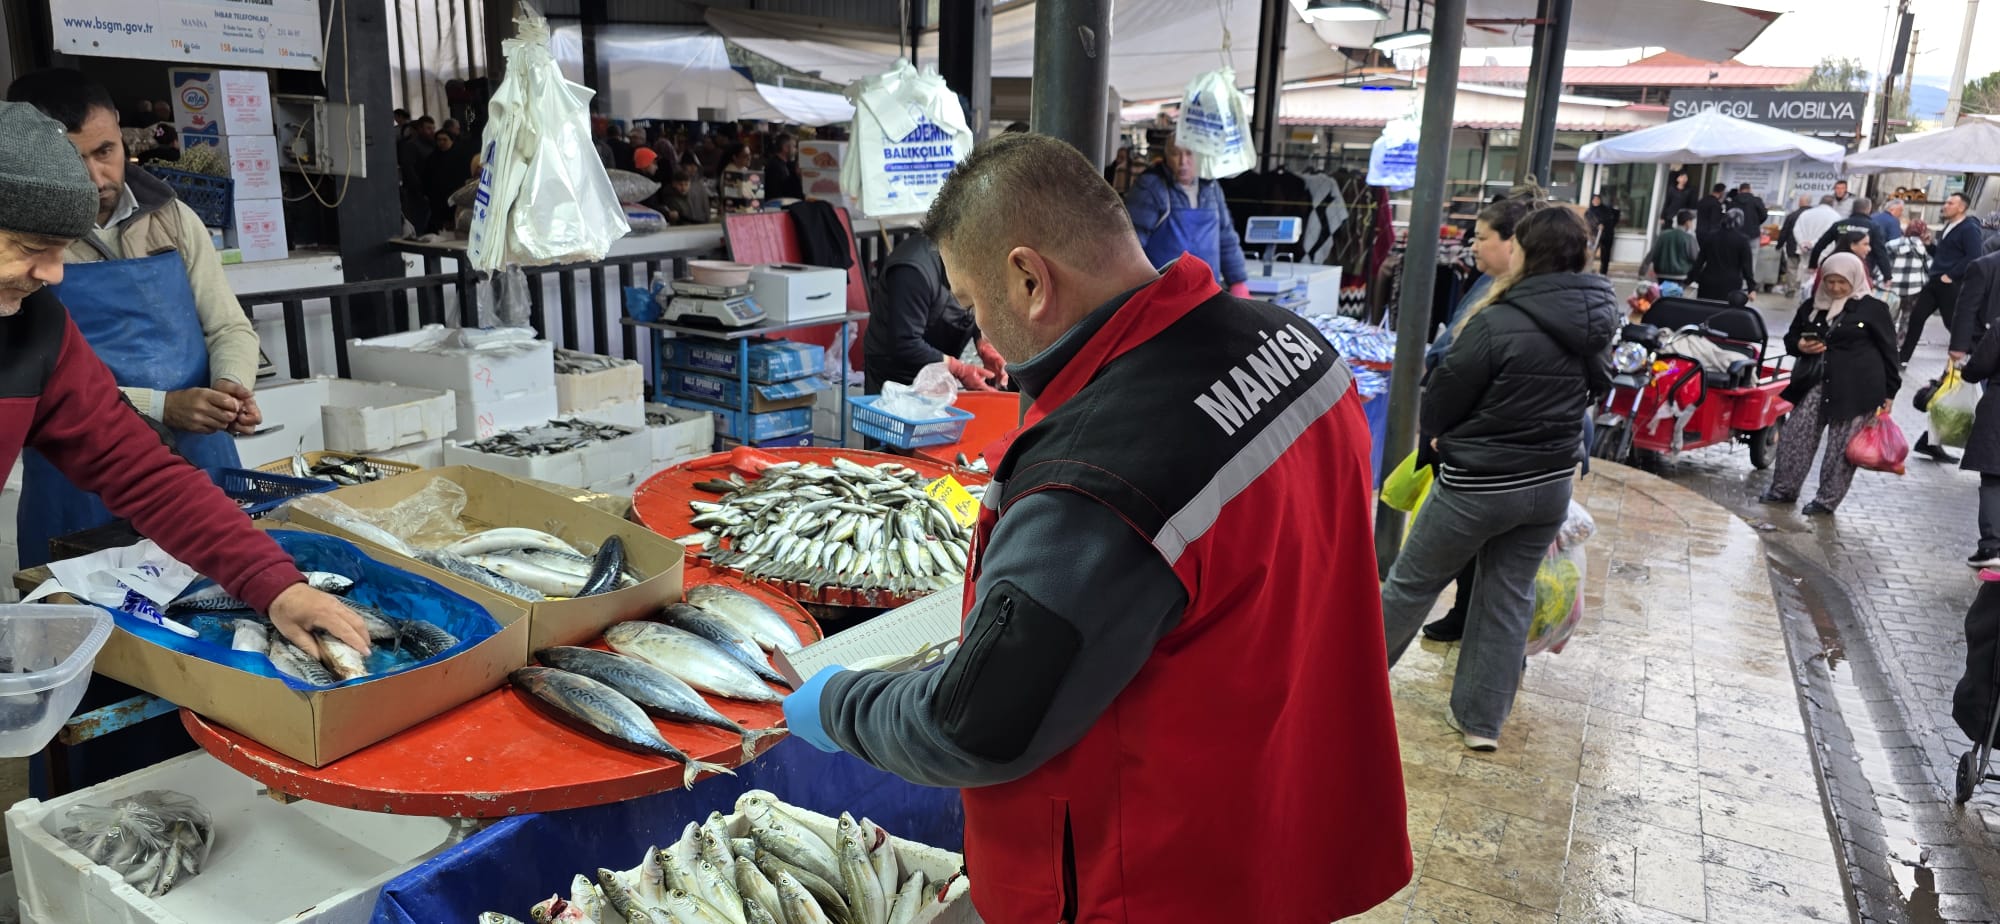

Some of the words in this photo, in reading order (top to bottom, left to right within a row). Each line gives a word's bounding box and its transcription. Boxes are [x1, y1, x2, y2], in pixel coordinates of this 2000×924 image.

[64, 16, 153, 35] www.bsgm.gov.tr
[171, 39, 183, 49] 174
[883, 145, 954, 161] BALIKÇILIK
[1193, 323, 1323, 436] MANİSA
